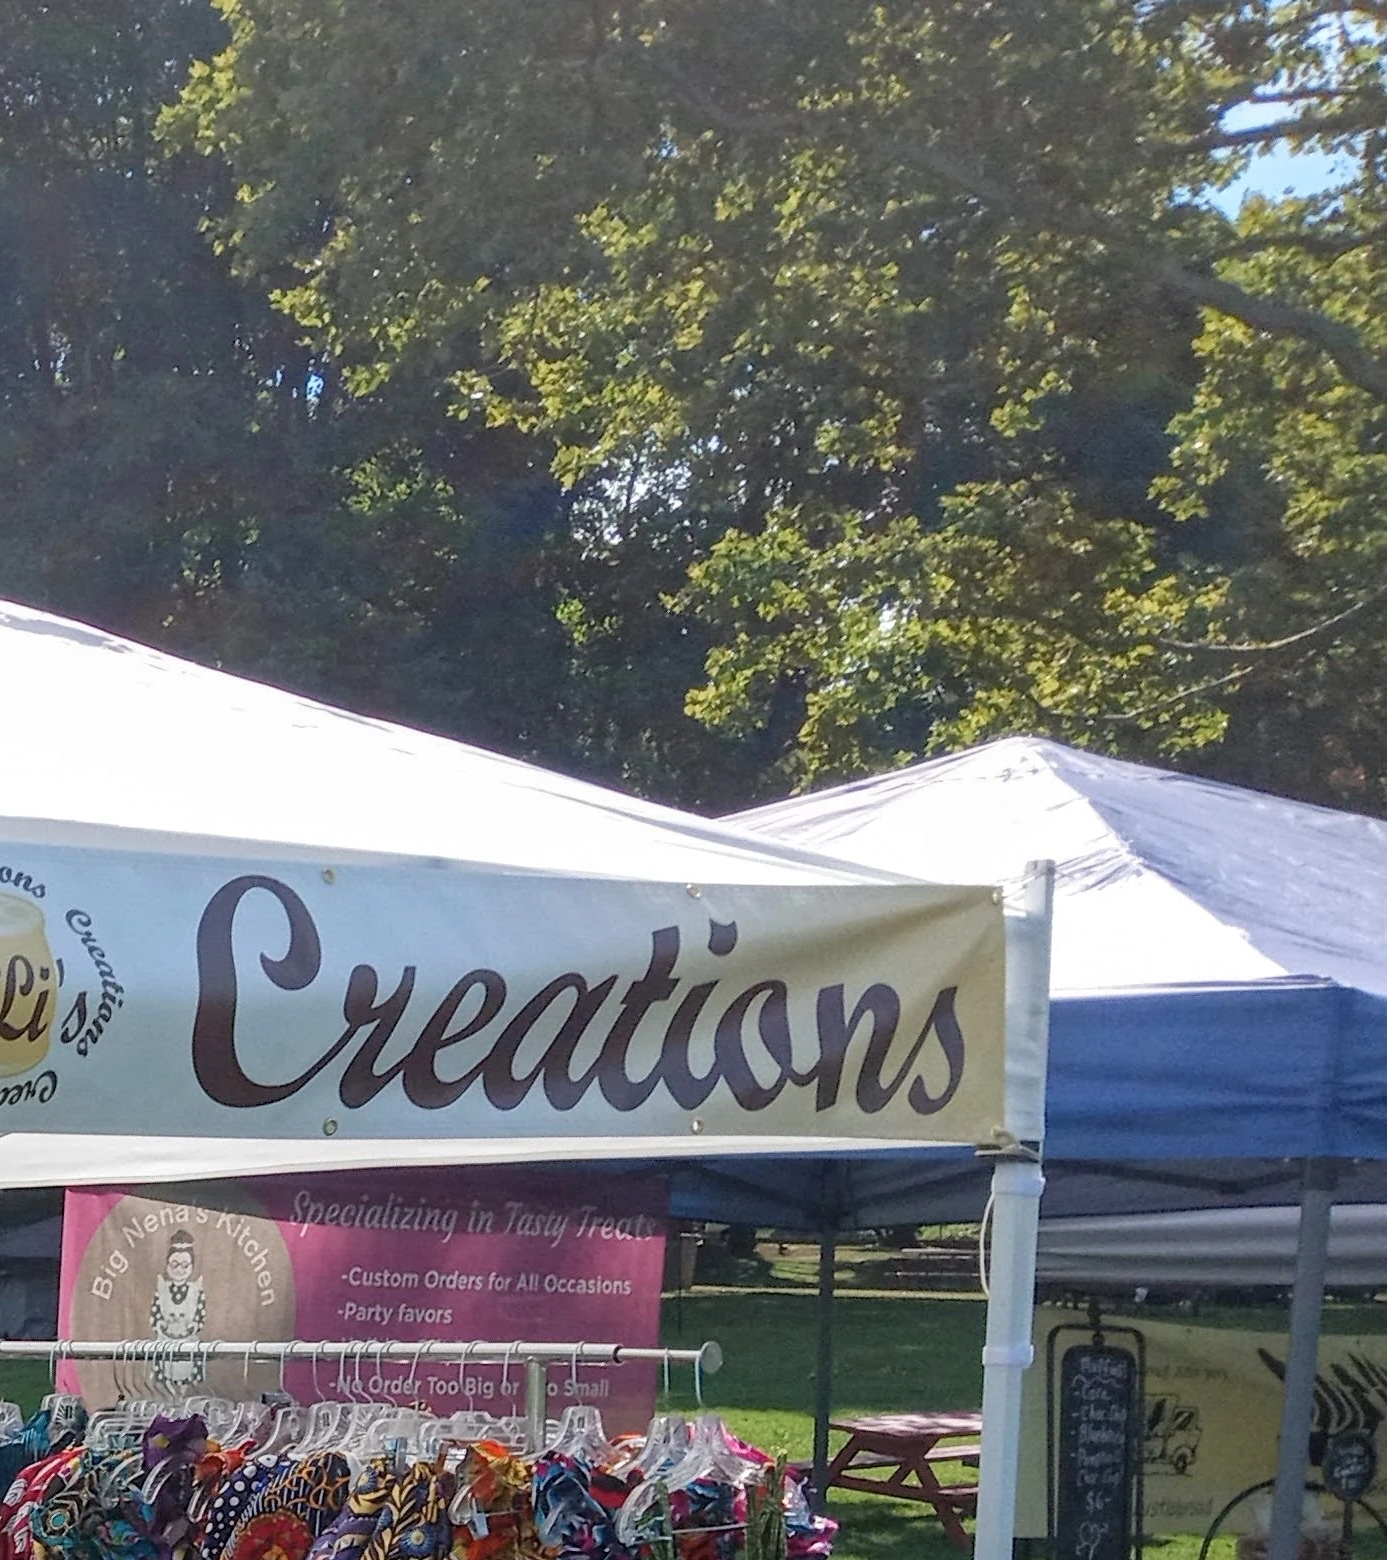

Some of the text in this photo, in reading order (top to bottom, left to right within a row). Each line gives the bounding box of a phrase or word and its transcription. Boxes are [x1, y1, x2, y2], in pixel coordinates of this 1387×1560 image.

[65, 909, 124, 1057] Creations
[192, 873, 965, 1116] Creations
[290, 1190, 657, 1247] Specializing in Tasty Treats
[91, 1201, 275, 1306] Big Nena's Kitchen
[341, 1267, 632, 1295] -Custom Orders for All Occasions
[338, 1302, 452, 1325] -Party favors
[369, 1376, 421, 1395] Order
[427, 1377, 459, 1395] Too
[464, 1377, 494, 1398] Big
[563, 1379, 609, 1397] Small
